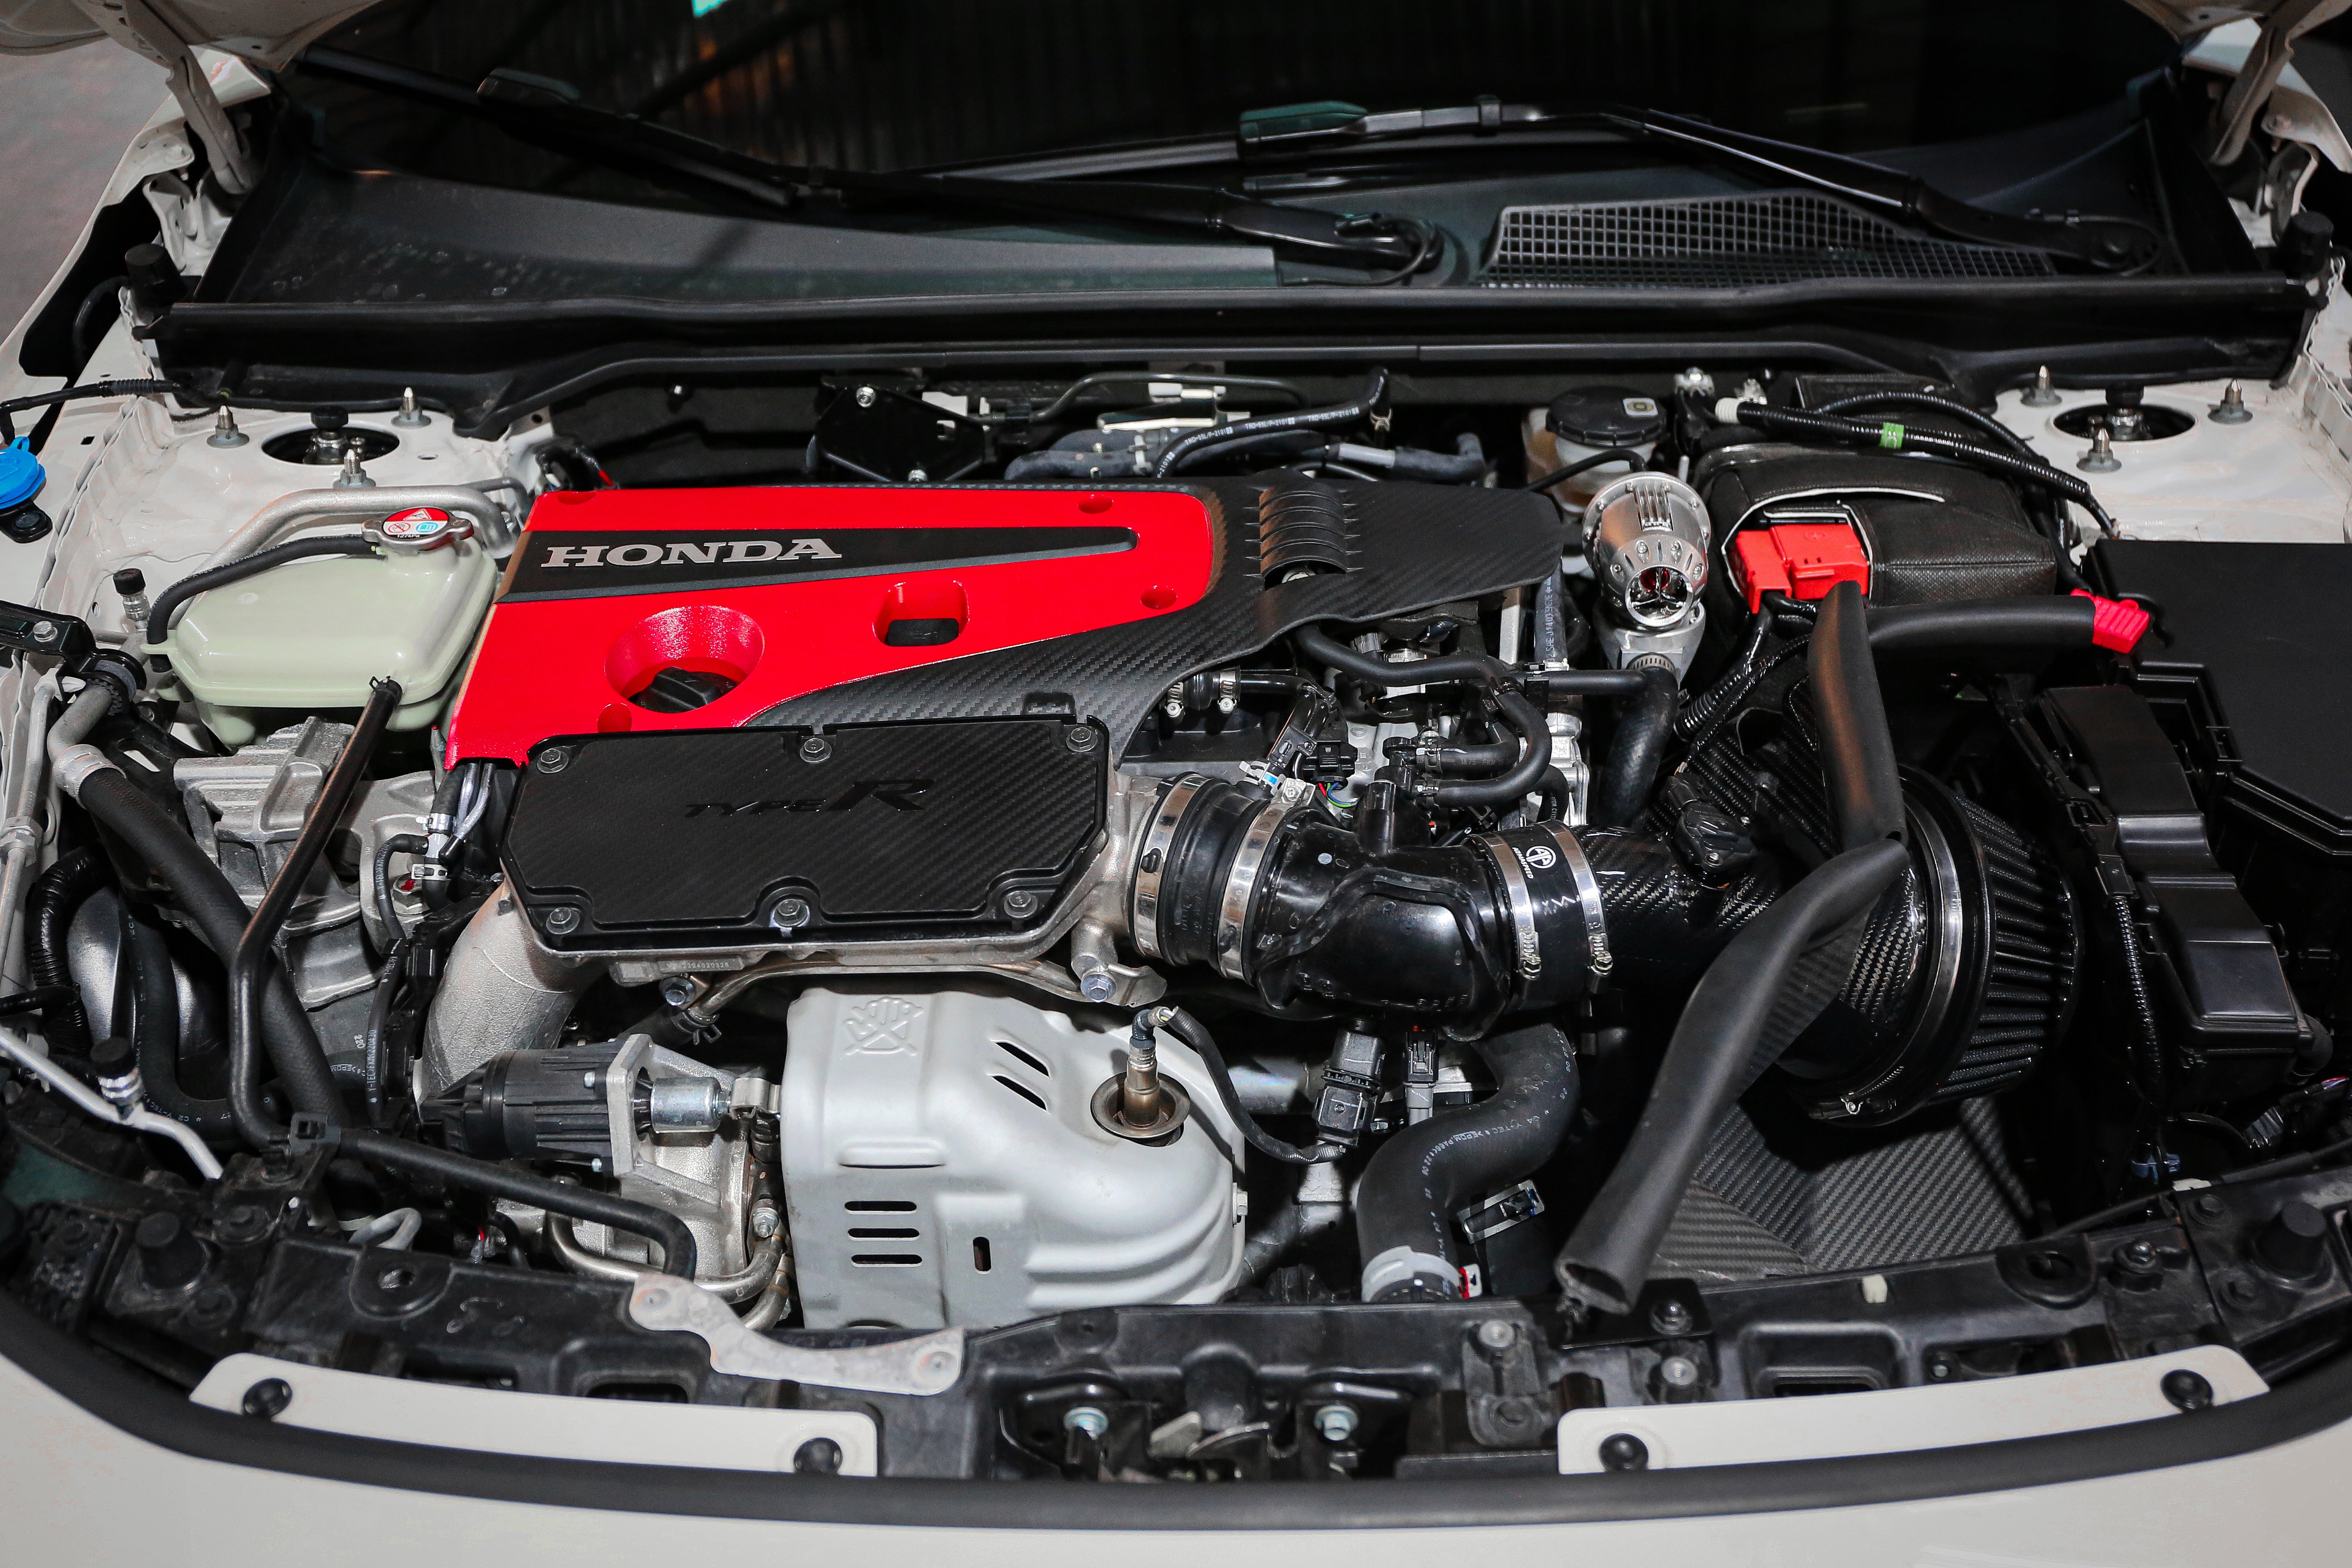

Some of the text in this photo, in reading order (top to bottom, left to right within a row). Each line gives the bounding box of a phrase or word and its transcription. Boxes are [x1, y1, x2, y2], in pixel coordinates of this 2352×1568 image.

[541, 538, 842, 568] HONDA
[684, 778, 935, 817] TYPE R
[1512, 847, 1534, 879] ARMASPEED
